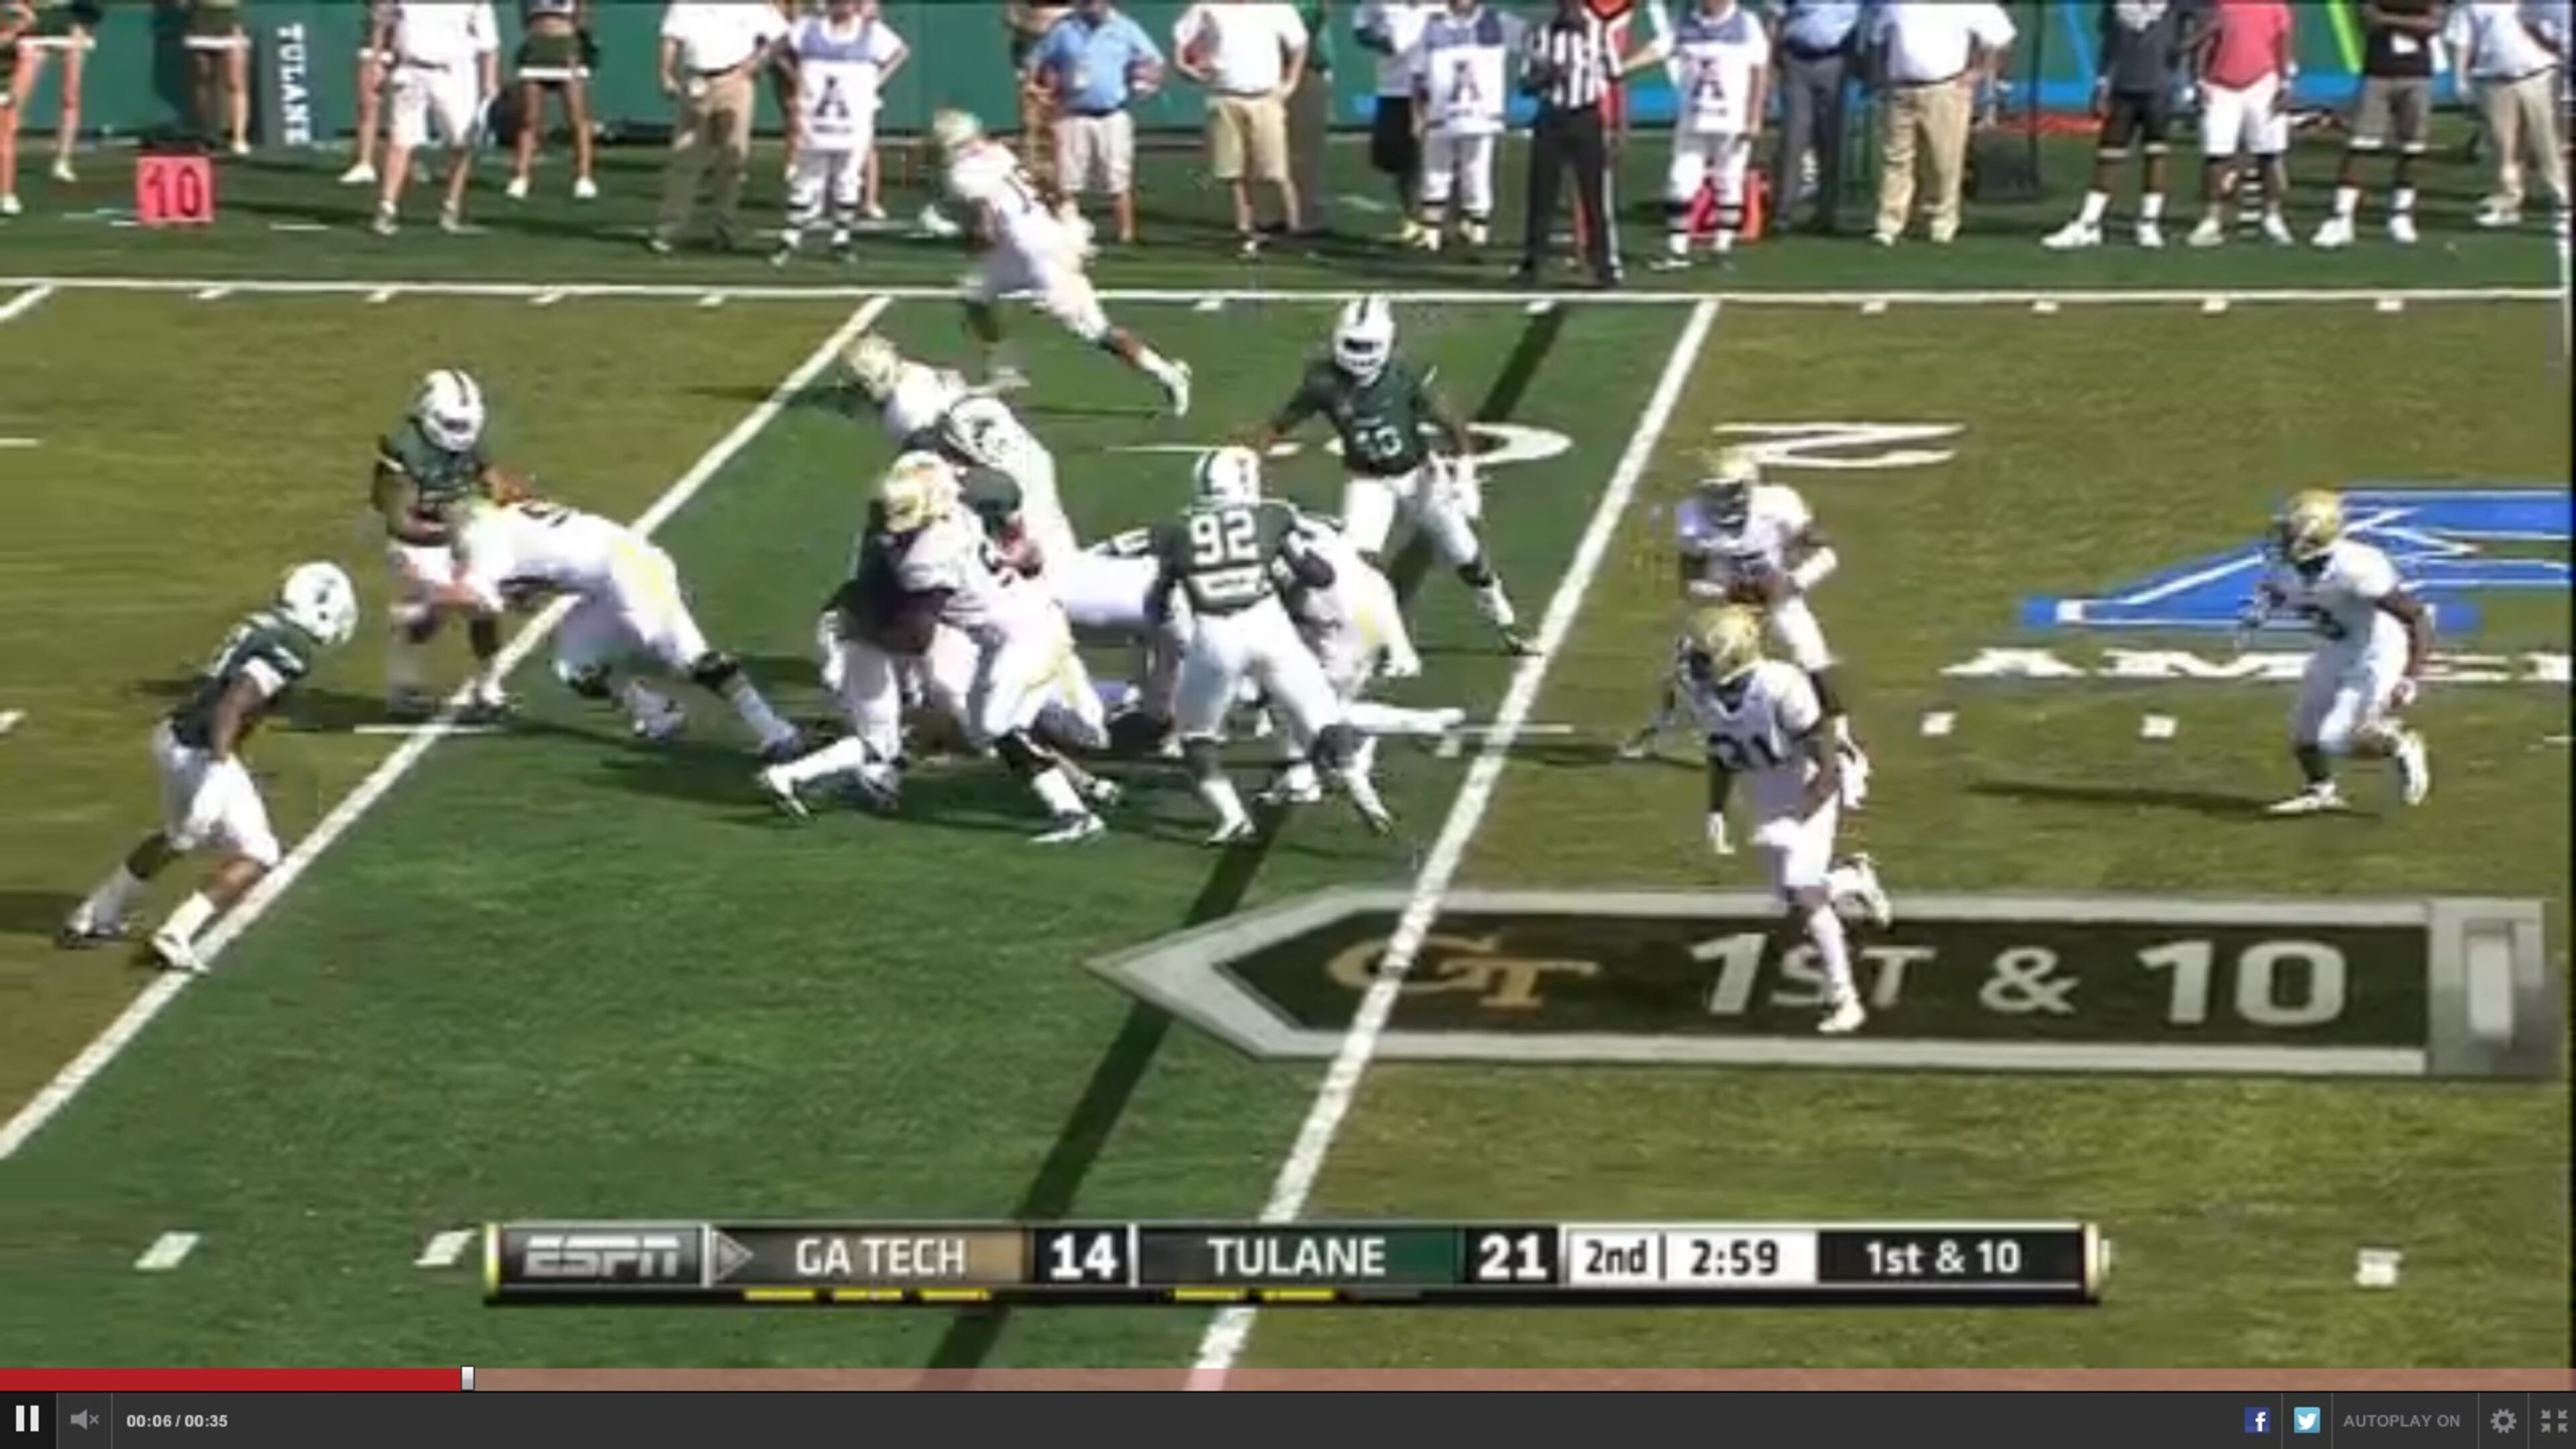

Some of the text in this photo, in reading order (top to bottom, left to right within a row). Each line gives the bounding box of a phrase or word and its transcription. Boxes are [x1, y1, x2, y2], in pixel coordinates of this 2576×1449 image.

[276, 22, 311, 145] TULANE
[144, 164, 203, 218] 10
[1190, 508, 1260, 566] 92
